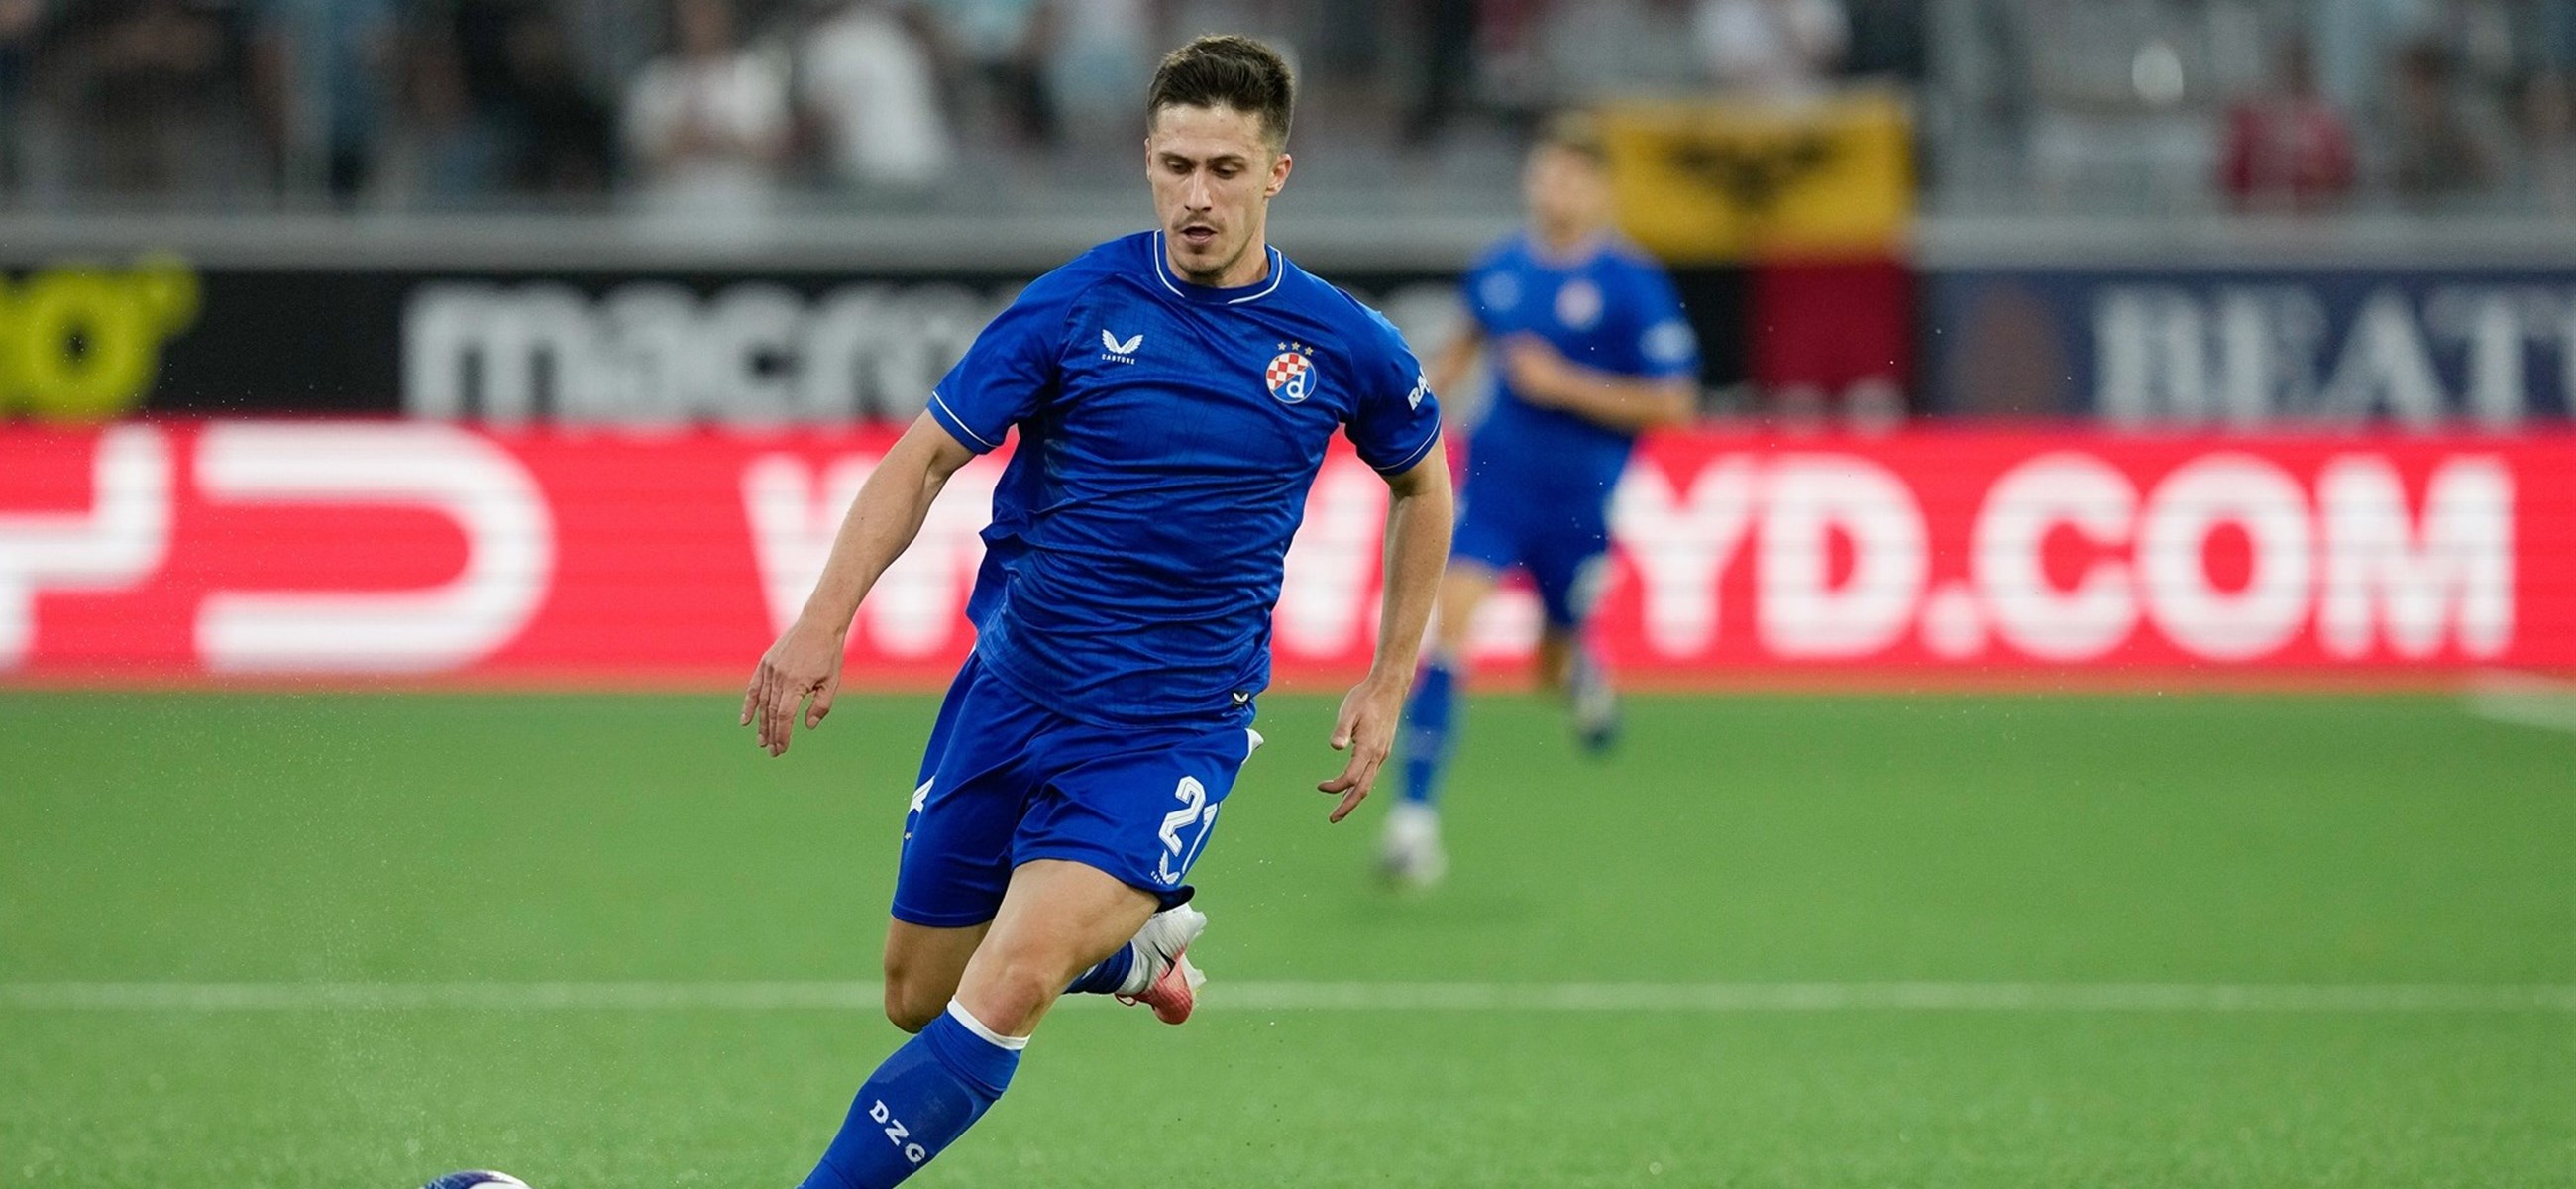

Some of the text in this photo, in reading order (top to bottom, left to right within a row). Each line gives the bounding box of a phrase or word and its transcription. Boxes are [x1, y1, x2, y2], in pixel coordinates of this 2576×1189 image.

[1407, 365, 1431, 411] RA
[2091, 287, 2576, 431] BEAT
[868, 1099, 926, 1163] DZG
